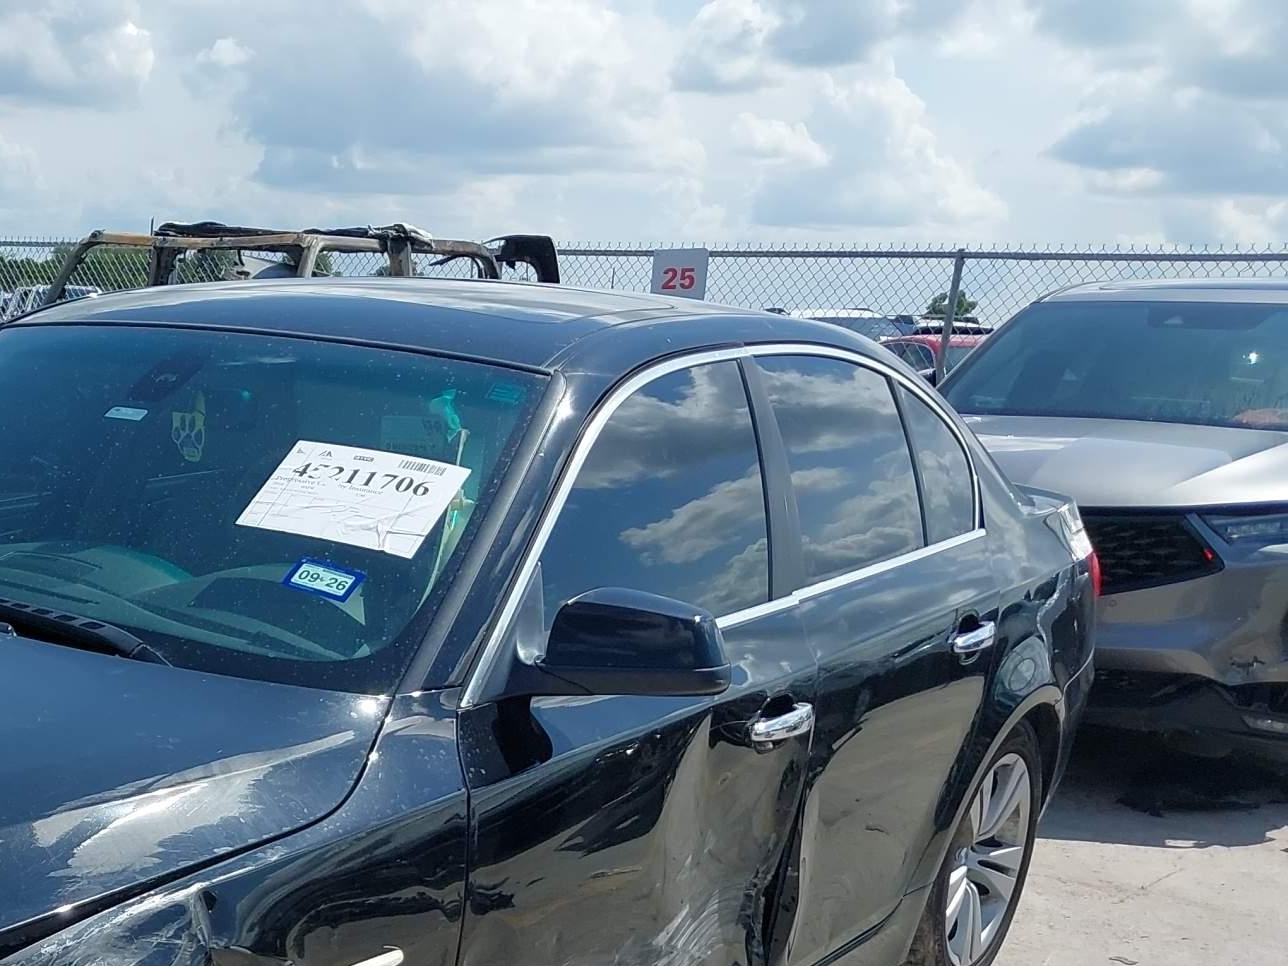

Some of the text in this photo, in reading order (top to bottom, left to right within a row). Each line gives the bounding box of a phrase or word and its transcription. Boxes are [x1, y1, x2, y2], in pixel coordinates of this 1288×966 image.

[662, 267, 695, 289] 25
[293, 462, 433, 497] 45211706
[299, 569, 321, 583] 09
[325, 577, 348, 591] 26
